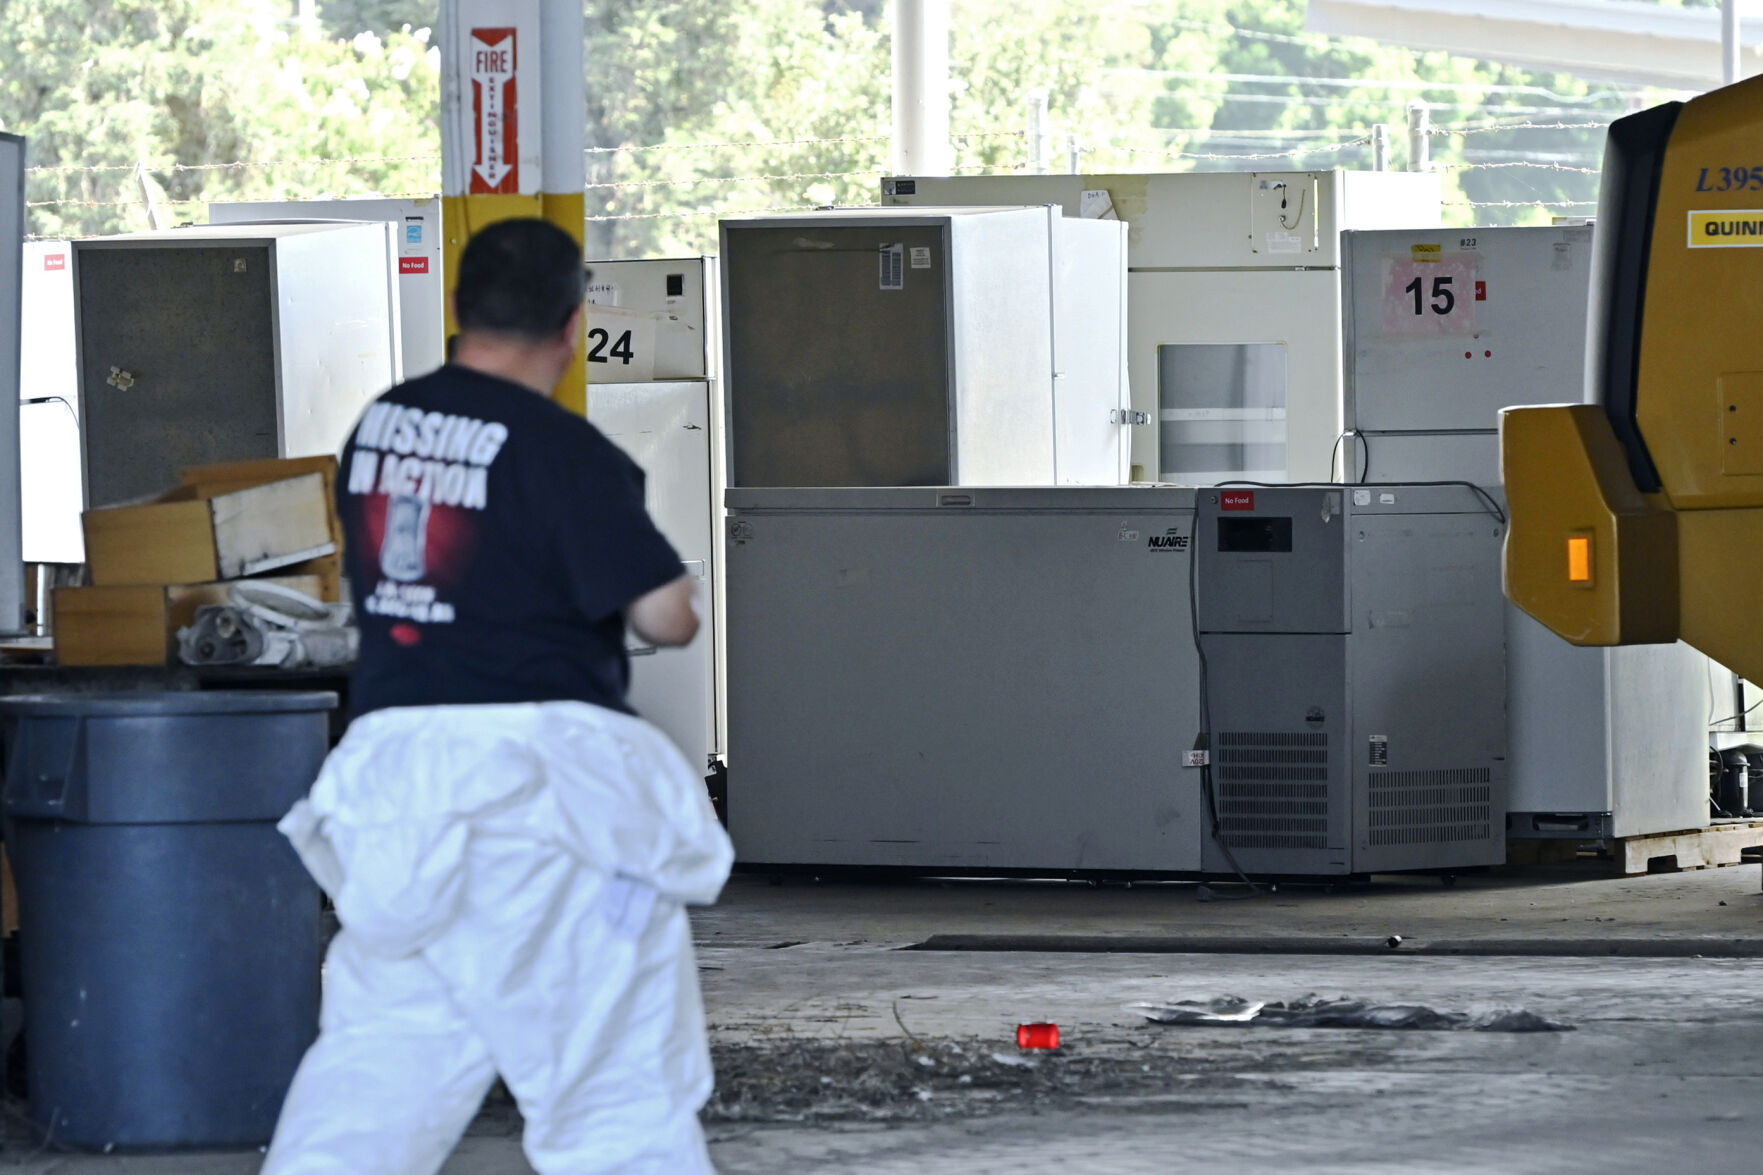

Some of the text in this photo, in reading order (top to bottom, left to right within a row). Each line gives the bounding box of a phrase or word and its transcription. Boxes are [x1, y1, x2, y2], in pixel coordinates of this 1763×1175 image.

[476, 51, 508, 74] FIRE
[487, 77, 498, 180] EXTINGUISHER
[1460, 238, 1477, 247] #23
[1405, 276, 1455, 315] 15
[587, 327, 634, 365] 24
[355, 401, 509, 466] MISSING
[378, 453, 488, 511] ACTION
[1225, 497, 1249, 505] No Food
[1148, 536, 1189, 547] NUAIRE
